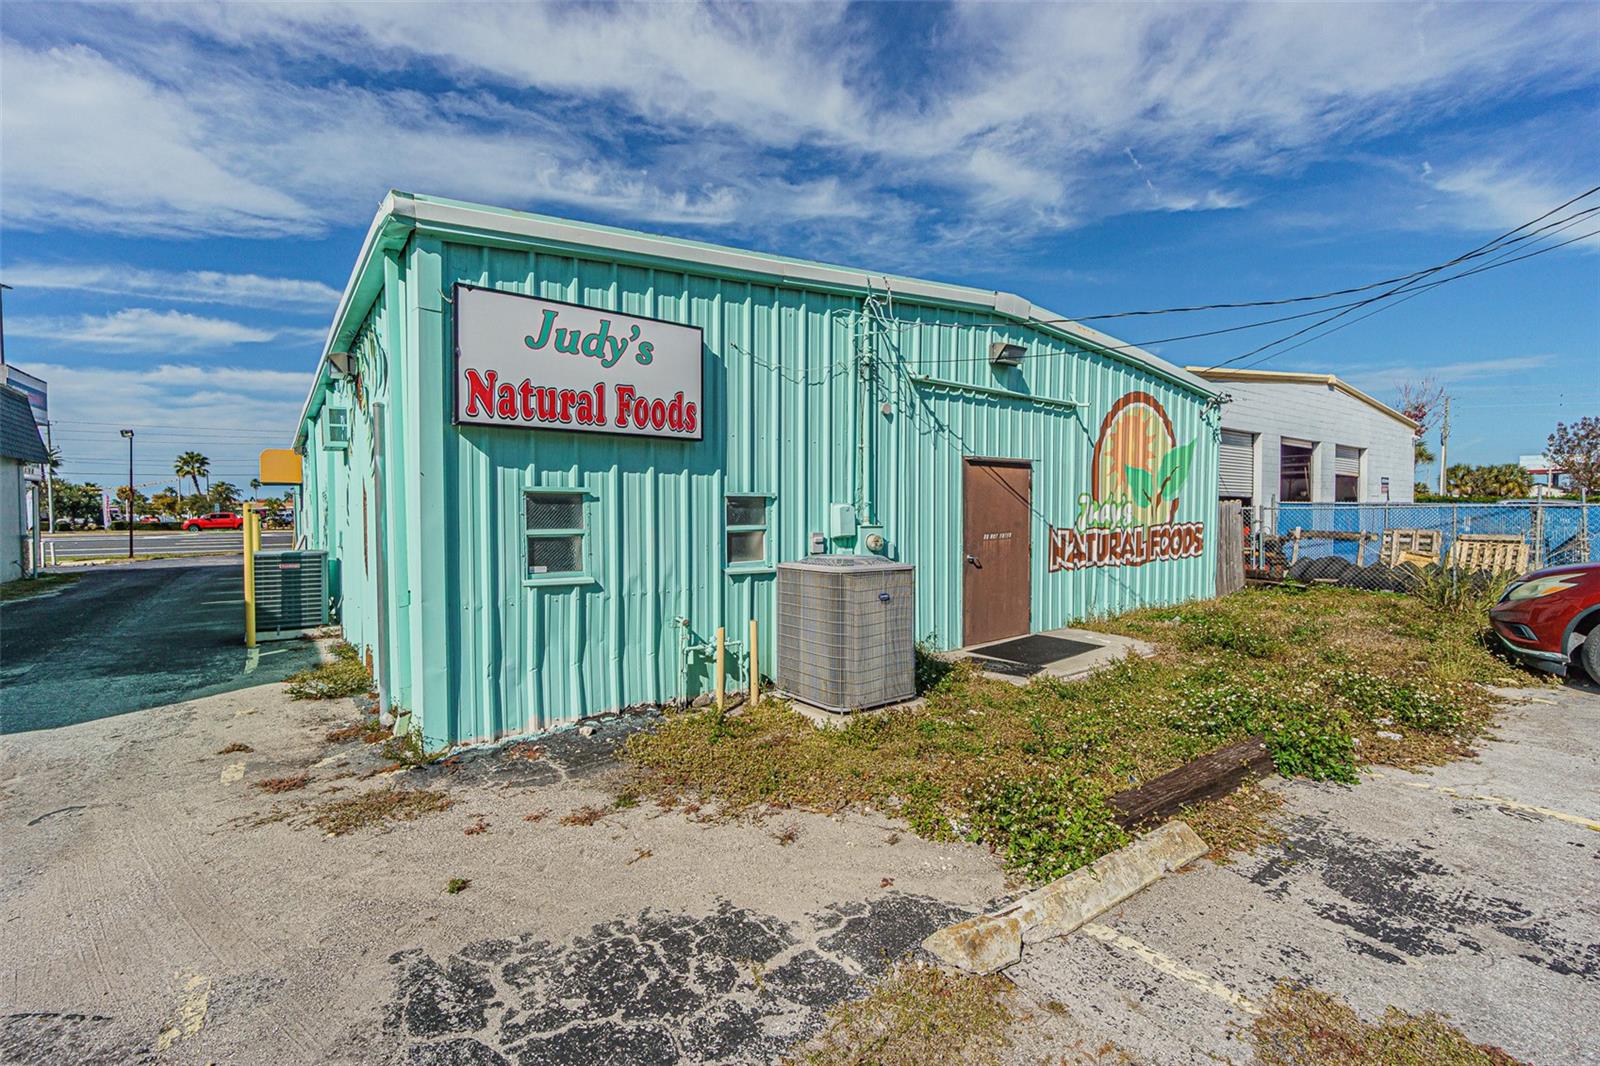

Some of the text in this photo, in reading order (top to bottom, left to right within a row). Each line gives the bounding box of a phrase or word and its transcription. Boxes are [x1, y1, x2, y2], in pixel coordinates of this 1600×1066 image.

[524, 309, 654, 368] Judy's
[465, 369, 697, 433] Natural Foods
[1077, 492, 1133, 535] Judy's
[1048, 521, 1204, 573] NATURAL FOODS
